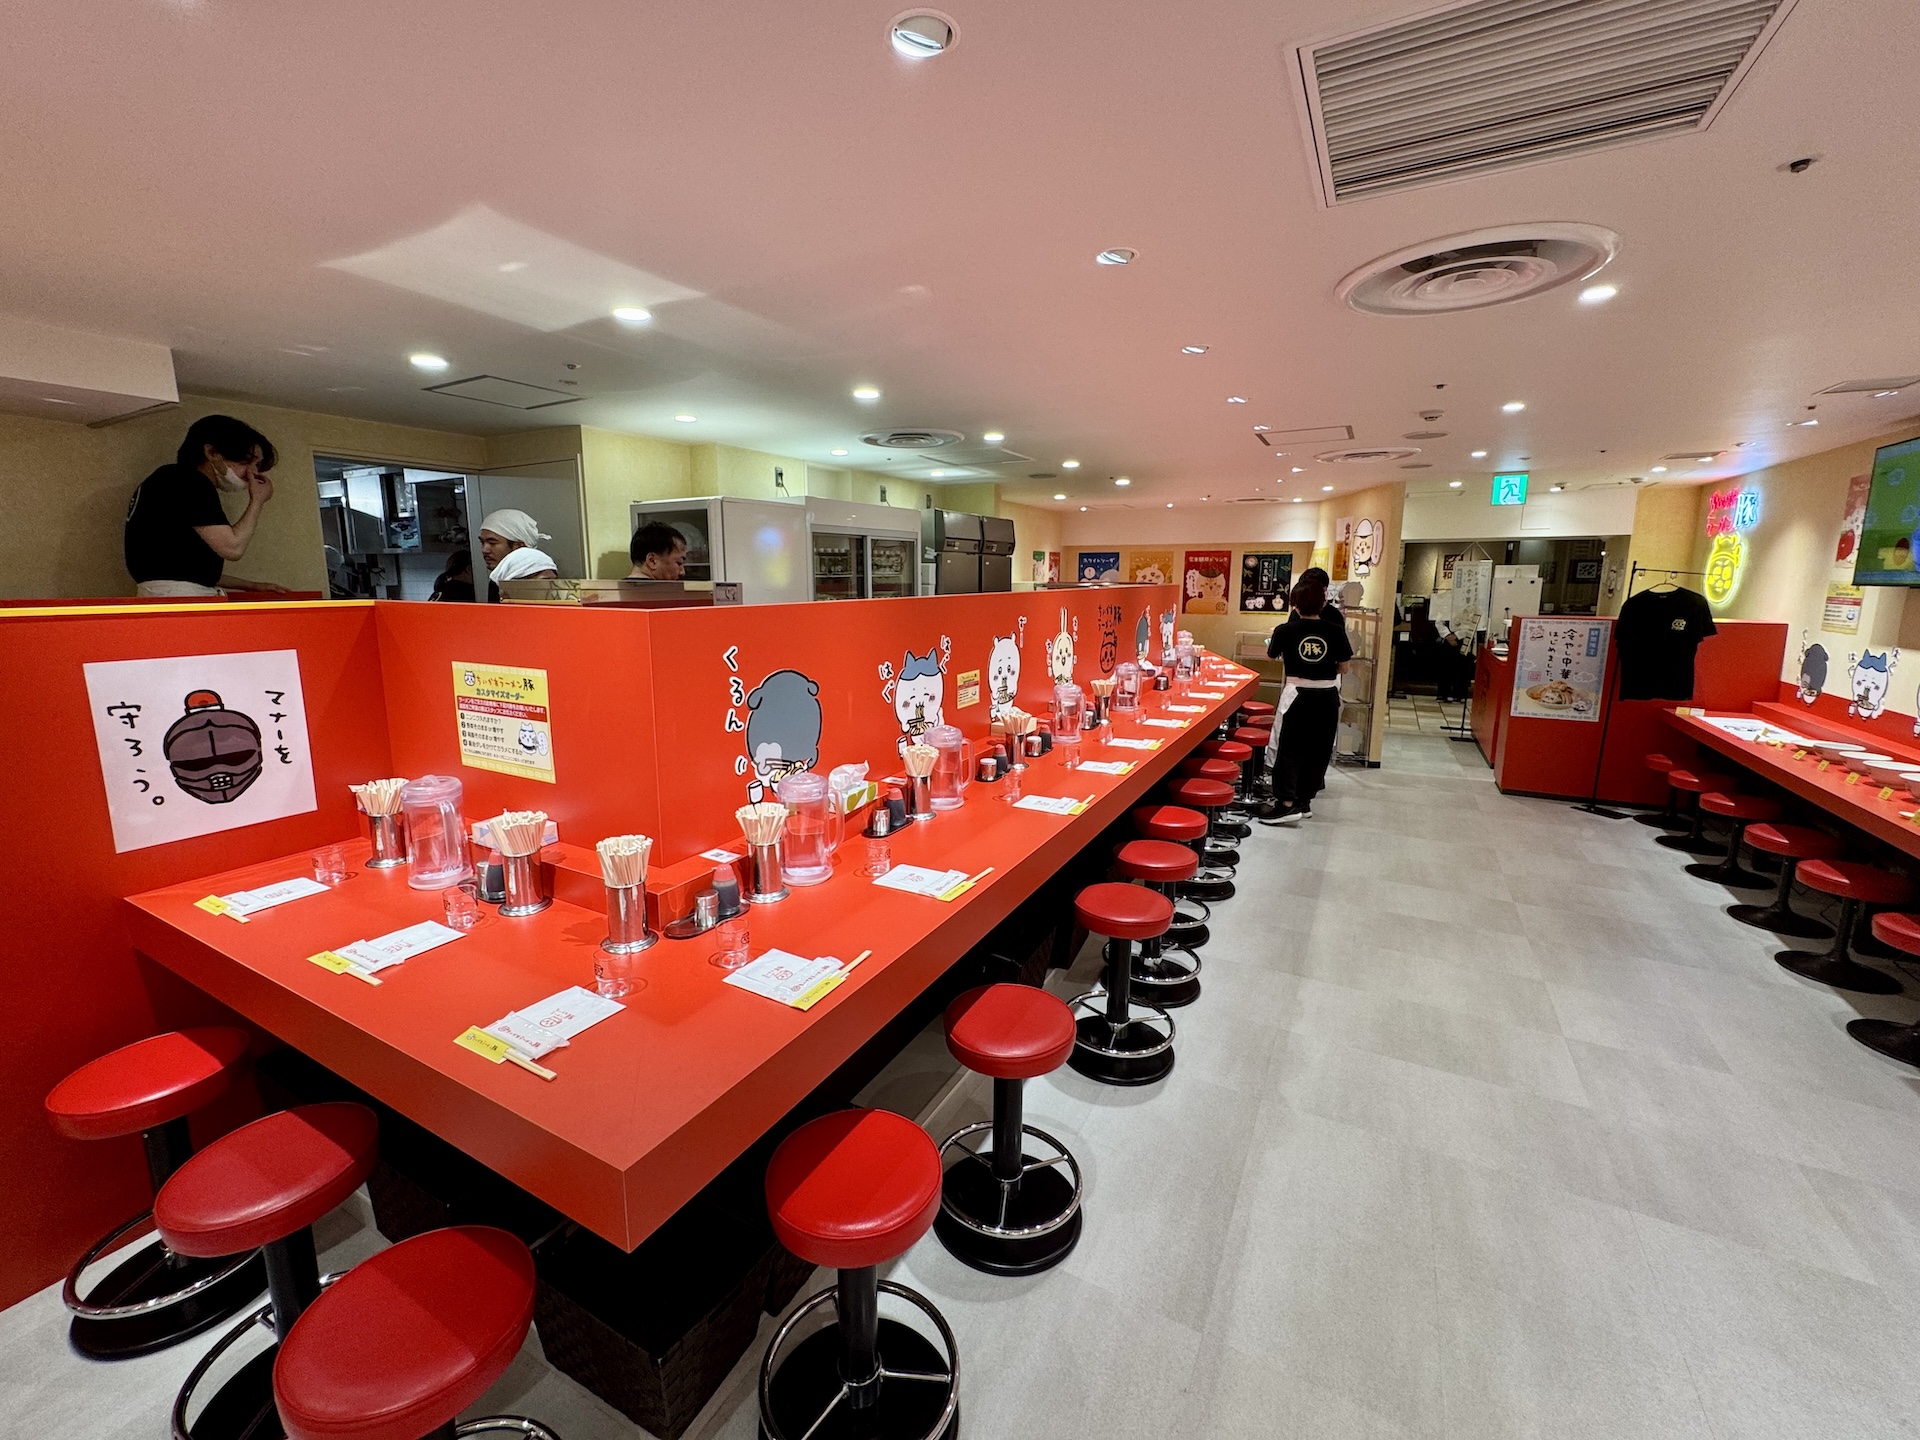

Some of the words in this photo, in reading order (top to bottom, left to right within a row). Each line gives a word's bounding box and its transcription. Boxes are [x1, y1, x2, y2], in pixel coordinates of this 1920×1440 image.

[1303, 642, 1322, 656] 豚
[1559, 628, 1577, 680] 冷やし中華
[476, 688, 525, 700] カスタマイズオーダー
[725, 647, 744, 730] くるん
[264, 690, 293, 765] マナーを
